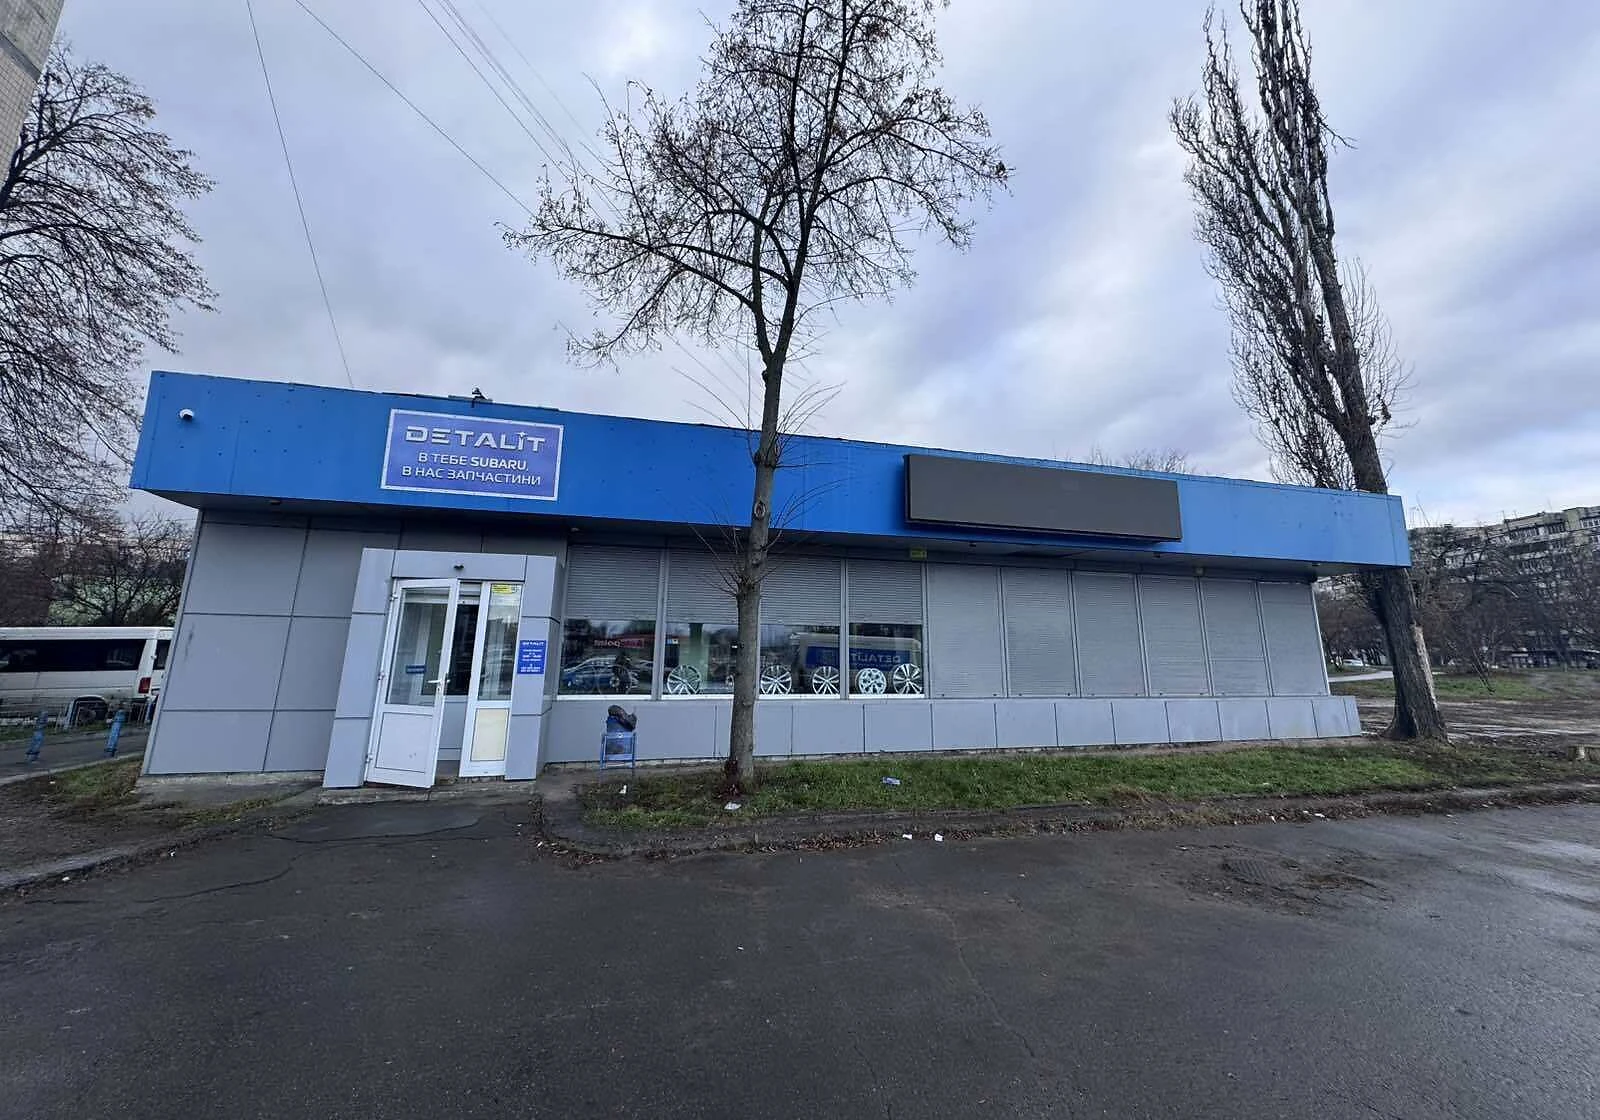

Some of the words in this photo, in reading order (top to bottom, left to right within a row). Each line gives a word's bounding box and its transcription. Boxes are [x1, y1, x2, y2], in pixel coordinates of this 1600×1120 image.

[419, 453, 428, 463] В
[433, 454, 467, 466] ТЕБЕ
[402, 466, 412, 476] В
[416, 468, 444, 479] НАС
[447, 470, 541, 486] ЗАПЧАСТИНИ
